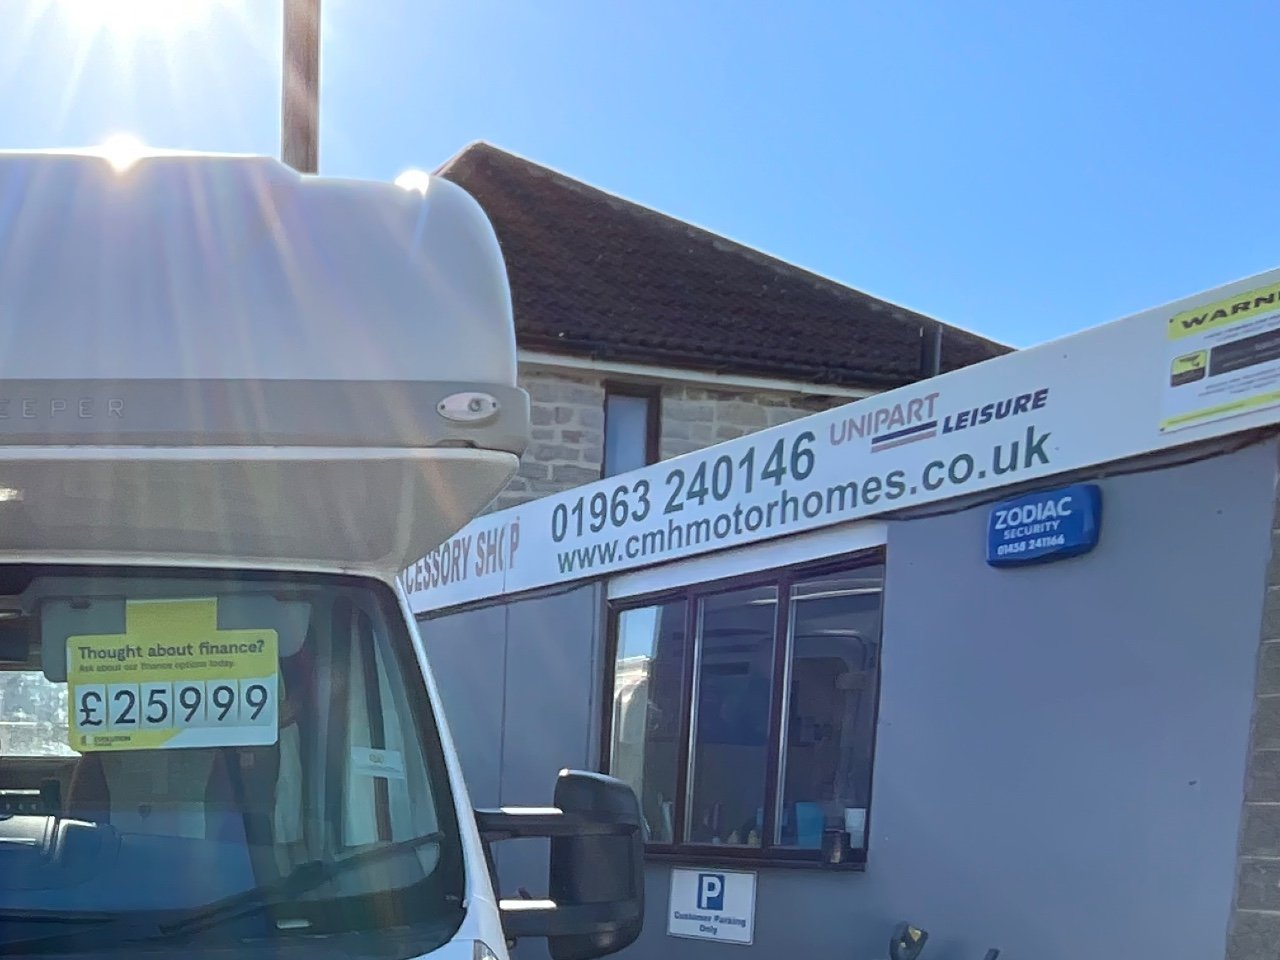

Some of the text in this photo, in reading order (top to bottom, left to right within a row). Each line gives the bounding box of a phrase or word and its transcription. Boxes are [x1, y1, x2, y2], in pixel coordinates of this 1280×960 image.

[829, 388, 1049, 446] UNIPART LEISURE
[552, 431, 816, 542] 01963 240146
[557, 425, 1052, 574] www.cmhmotorhomes.co.uk
[995, 496, 1072, 530] ZODIAC
[1003, 519, 1061, 540] SECURITY
[403, 535, 472, 594] CESSORY
[78, 639, 265, 662] Thought about finance?
[96, 663, 122, 672] about
[175, 661, 207, 671] options
[79, 684, 268, 727] £25999
[700, 875, 722, 908] P
[673, 911, 746, 927] Customer Parking
[699, 923, 718, 935] Only
